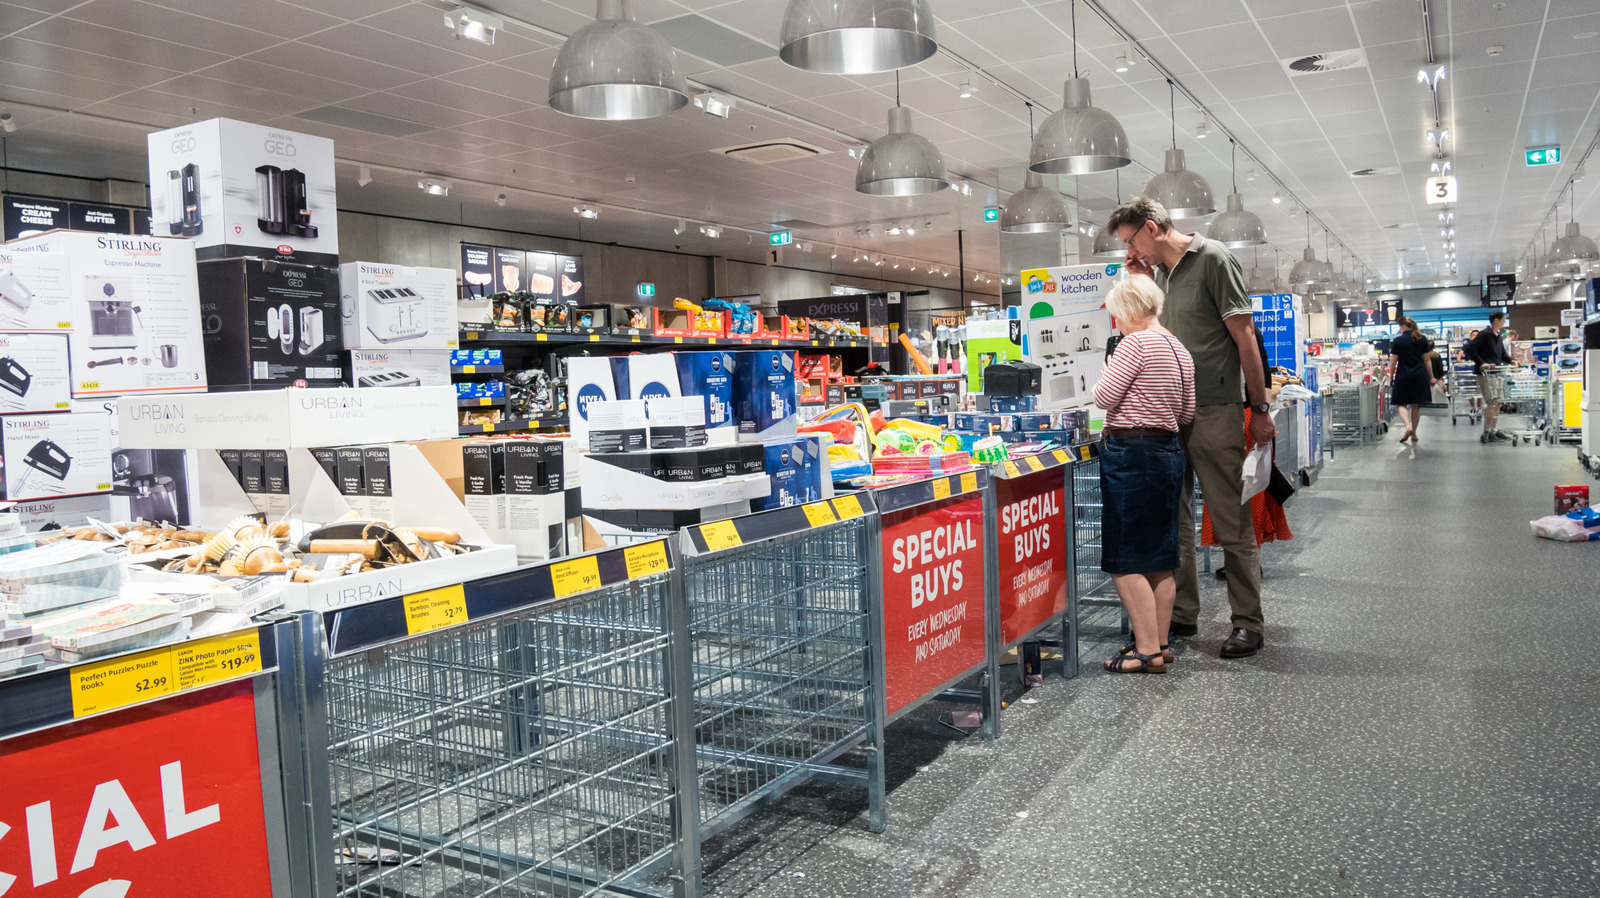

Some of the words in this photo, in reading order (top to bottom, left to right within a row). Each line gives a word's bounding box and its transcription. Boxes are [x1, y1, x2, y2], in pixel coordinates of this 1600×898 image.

[264, 139, 297, 157] GEO
[1435, 182, 1448, 198] 3
[21, 208, 52, 218] CREAM
[20, 215, 54, 226] CHEESE
[84, 214, 116, 225] BUTTER
[97, 236, 162, 252] STIRLING
[771, 250, 777, 262] 1
[104, 259, 134, 267] Espresso
[134, 260, 161, 268] Machine
[361, 265, 394, 275] STIRLING
[1061, 270, 1102, 282] wooden
[288, 278, 304, 287] GEO
[1061, 282, 1098, 294] kitchen
[808, 301, 859, 316] EXPRESSI
[932, 316, 957, 326] MIXED
[1253, 314, 1281, 323] RLING
[355, 353, 389, 361] STIRLING
[194, 372, 199, 381] 3
[301, 397, 362, 410] URBAN
[579, 395, 603, 404] NIVEA
[131, 403, 184, 420] URBAN
[329, 410, 364, 419] LIVING
[6, 420, 50, 429] STIRLING
[155, 423, 186, 434] LIVING
[544, 444, 562, 452] URBAN
[701, 467, 723, 475] URBAN
[743, 461, 762, 469] URBAN
[601, 494, 623, 503] Candle
[725, 488, 744, 498] Candle
[13, 503, 55, 513] STIRLING
[1001, 491, 1060, 534] SPECIAL
[892, 518, 978, 574] SPECIAL
[1014, 523, 1050, 564] BUYS
[648, 558, 665, 568] $29.99
[582, 574, 597, 584] $9.99
[1013, 570, 1028, 591] EVERY
[1027, 558, 1053, 584] WEDNESDAY
[910, 559, 963, 609] BUYS
[325, 578, 403, 607] URBAN
[1018, 590, 1028, 608] AND
[1027, 579, 1050, 604] SATURDAY
[409, 603, 430, 613] Bamboo
[430, 599, 451, 608] Cleaning
[444, 606, 463, 618] $2.79
[410, 611, 430, 620] Brushes
[908, 616, 929, 643] EVERY
[929, 601, 968, 632] WEDNESDAY
[915, 643, 929, 664] AND
[928, 625, 963, 656] SATURDAY
[177, 649, 194, 657] CANON
[178, 656, 195, 665] ZINK
[195, 651, 216, 662] Photo
[216, 647, 236, 659] Paper
[236, 643, 254, 654] 50pk
[179, 660, 205, 671] Compatible
[204, 658, 216, 666] with
[204, 663, 219, 672] Photo
[220, 653, 256, 671] $19.99
[80, 671, 107, 684] Perfect
[107, 666, 136, 678] Puzzles
[135, 659, 160, 671] Puzzle
[80, 680, 105, 692] Books
[135, 675, 167, 693] $2.99
[0, 759, 221, 898] IAL
